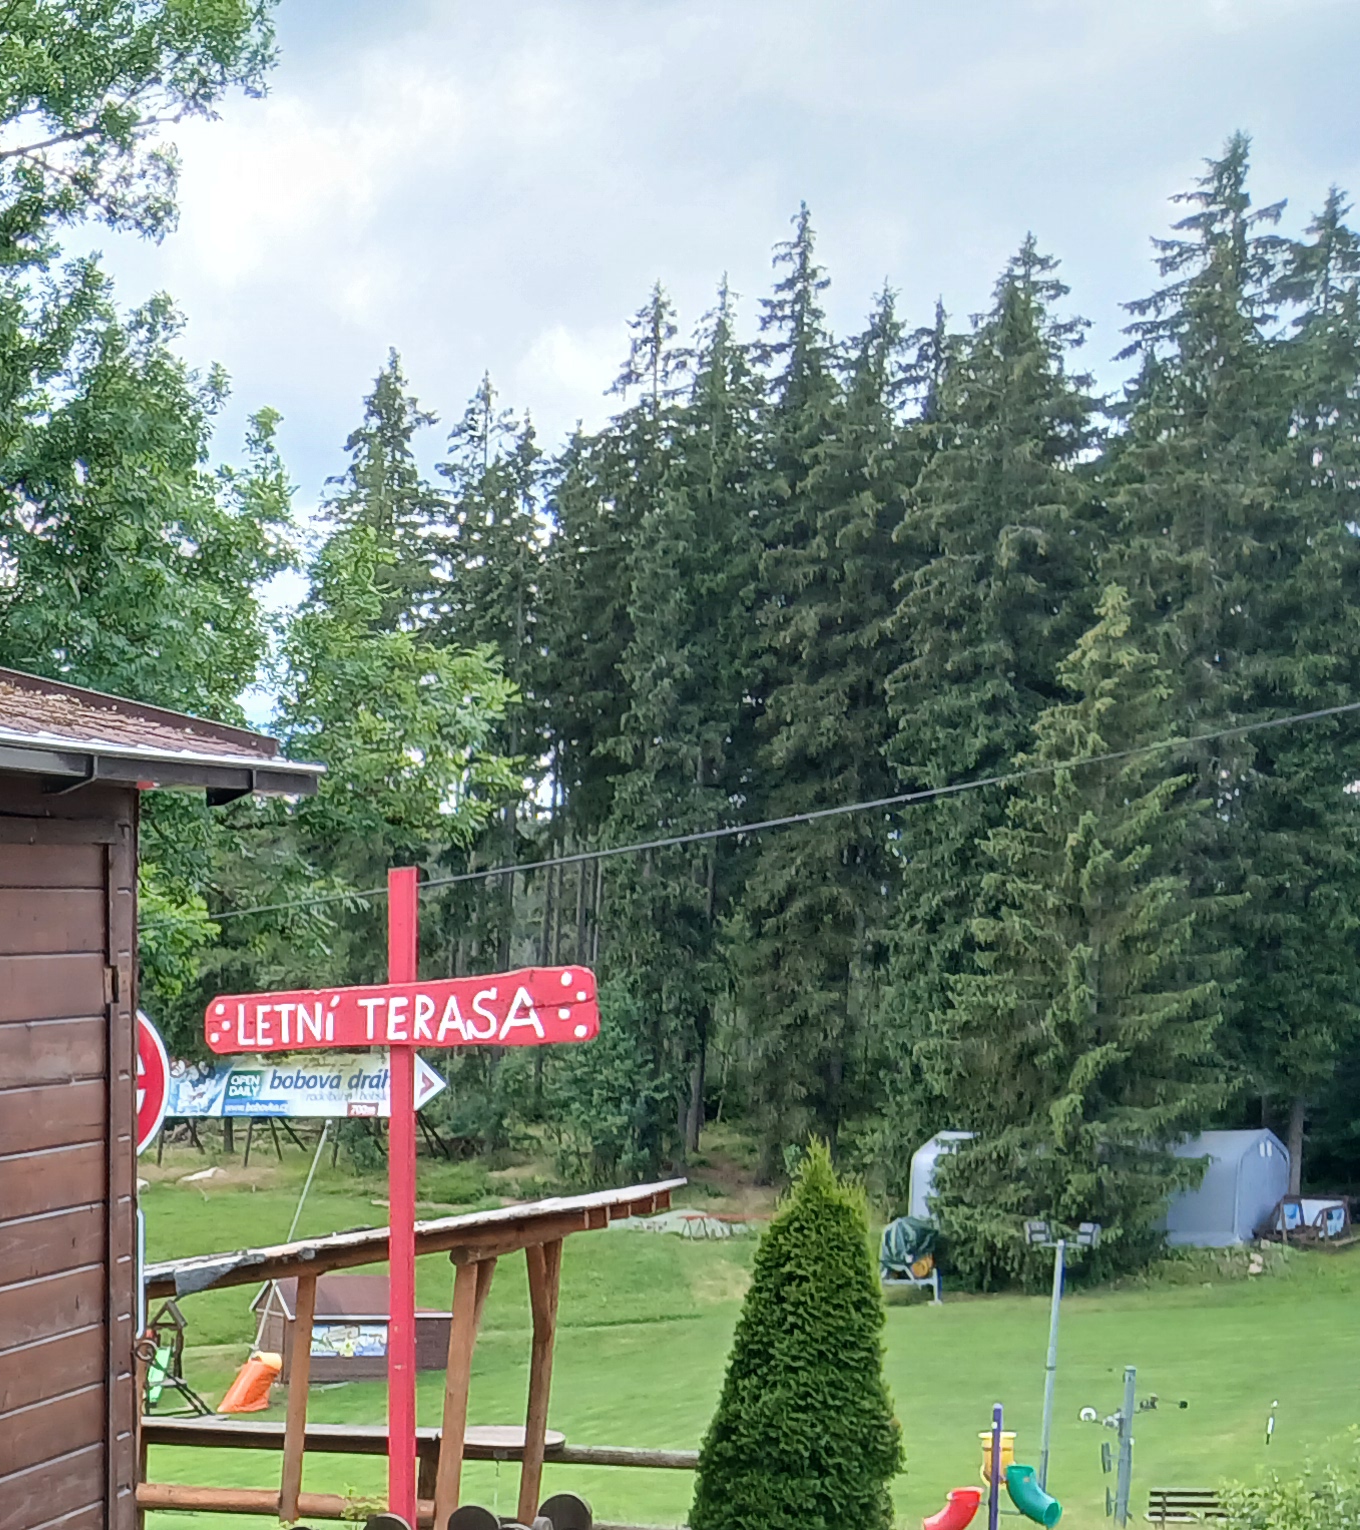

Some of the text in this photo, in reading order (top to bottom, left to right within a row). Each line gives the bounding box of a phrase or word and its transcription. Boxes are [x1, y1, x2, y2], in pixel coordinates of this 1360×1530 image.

[358, 986, 545, 1042] TERASA
[230, 1075, 261, 1085] OPEN
[269, 1069, 343, 1090] bobová
[229, 1086, 260, 1097] DAILY
